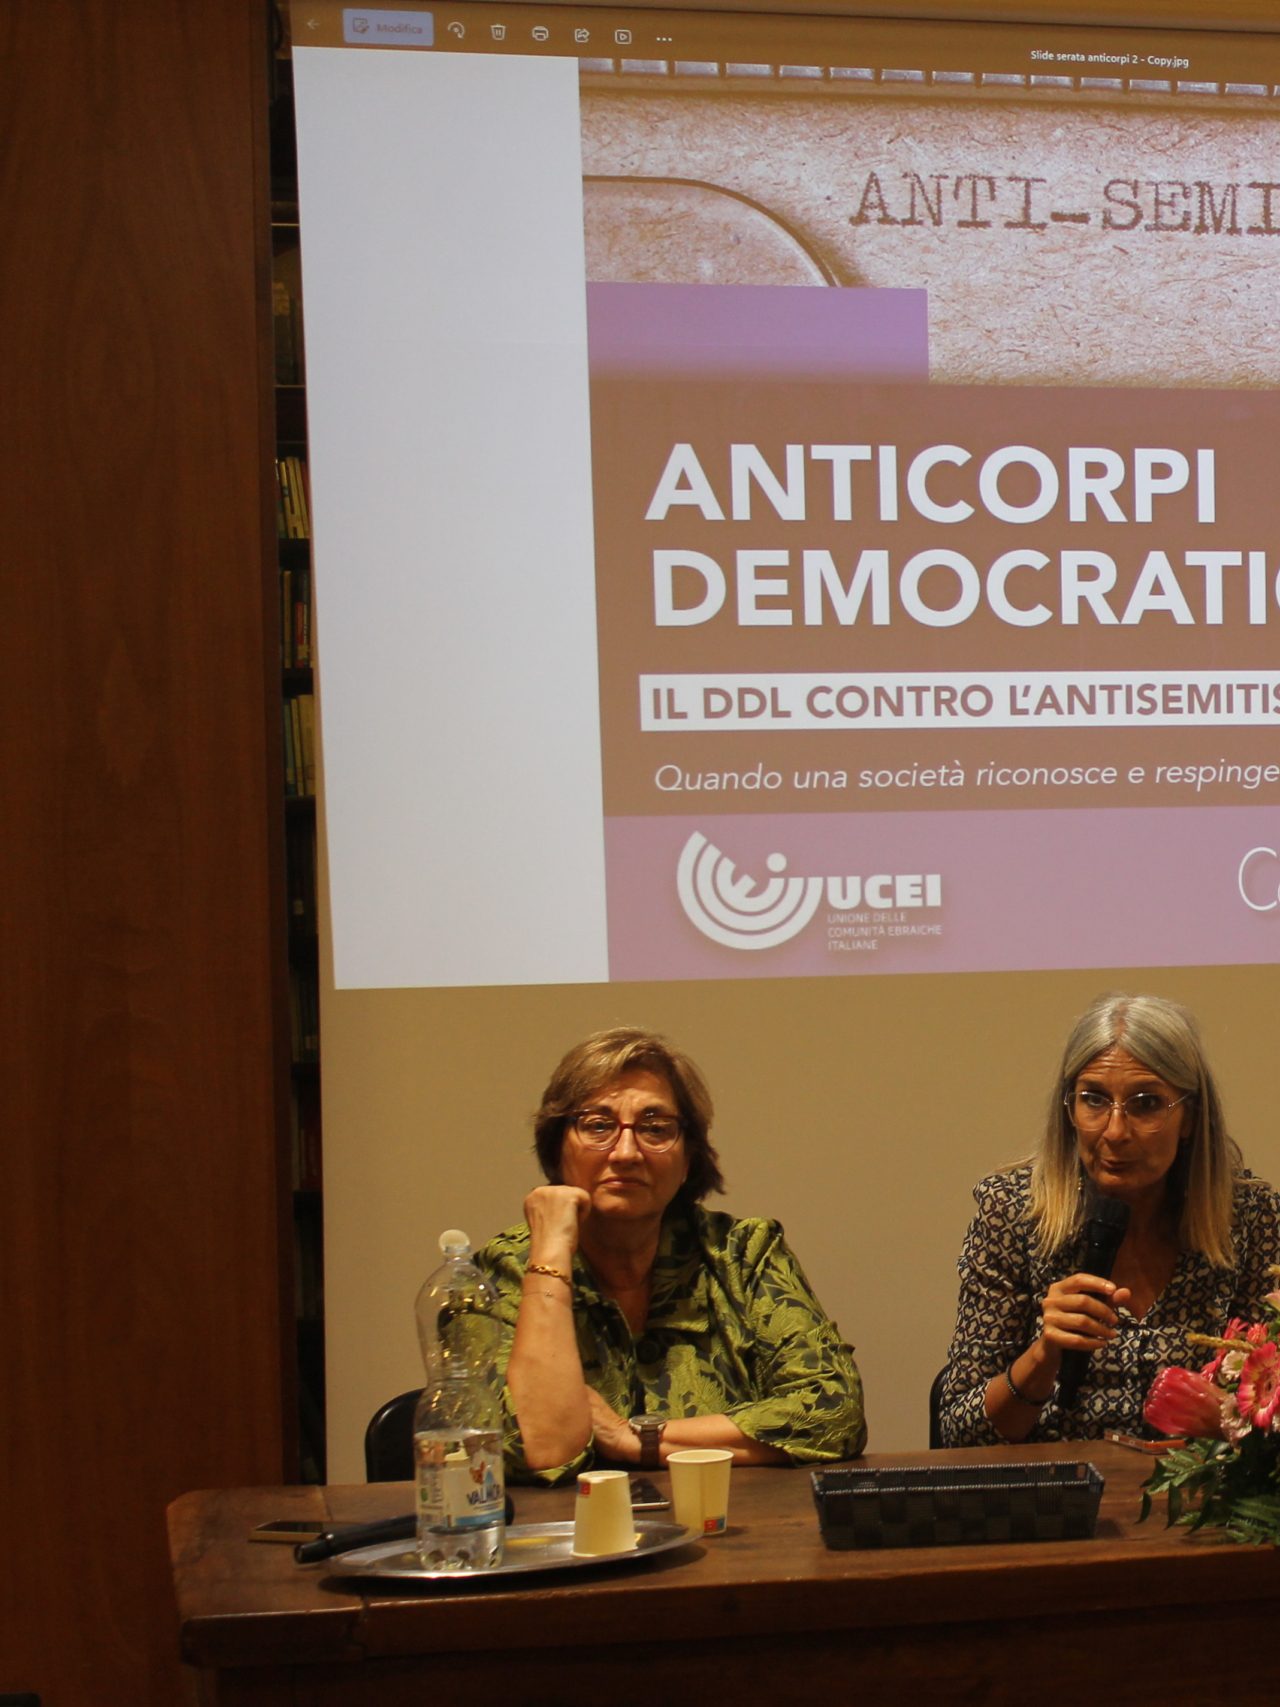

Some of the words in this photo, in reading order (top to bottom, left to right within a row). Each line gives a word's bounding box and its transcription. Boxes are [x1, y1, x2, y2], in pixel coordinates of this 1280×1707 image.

[376, 23, 423, 35] Modifica
[1030, 50, 1055, 61] Slide
[1056, 52, 1086, 63] serata
[1087, 53, 1130, 66] anticorpi
[1131, 55, 1139, 65] 2
[1147, 55, 1190, 69] Copy.jpg
[644, 443, 1216, 522] ANTICORPI
[652, 688, 688, 720] IL
[703, 687, 792, 719] DDL
[806, 685, 994, 718] CONTRO
[654, 763, 783, 792] Quando
[793, 768, 848, 789] una
[858, 760, 965, 788] società
[976, 761, 1118, 786] riconosce
[1127, 765, 1146, 784] e
[1155, 758, 1280, 792] respinge
[827, 874, 942, 910] UCEI
[827, 912, 871, 924] UNIONE
[873, 912, 907, 923] DELLE
[888, 924, 943, 937] EBRAICHE
[827, 939, 878, 951] ITALIANE
